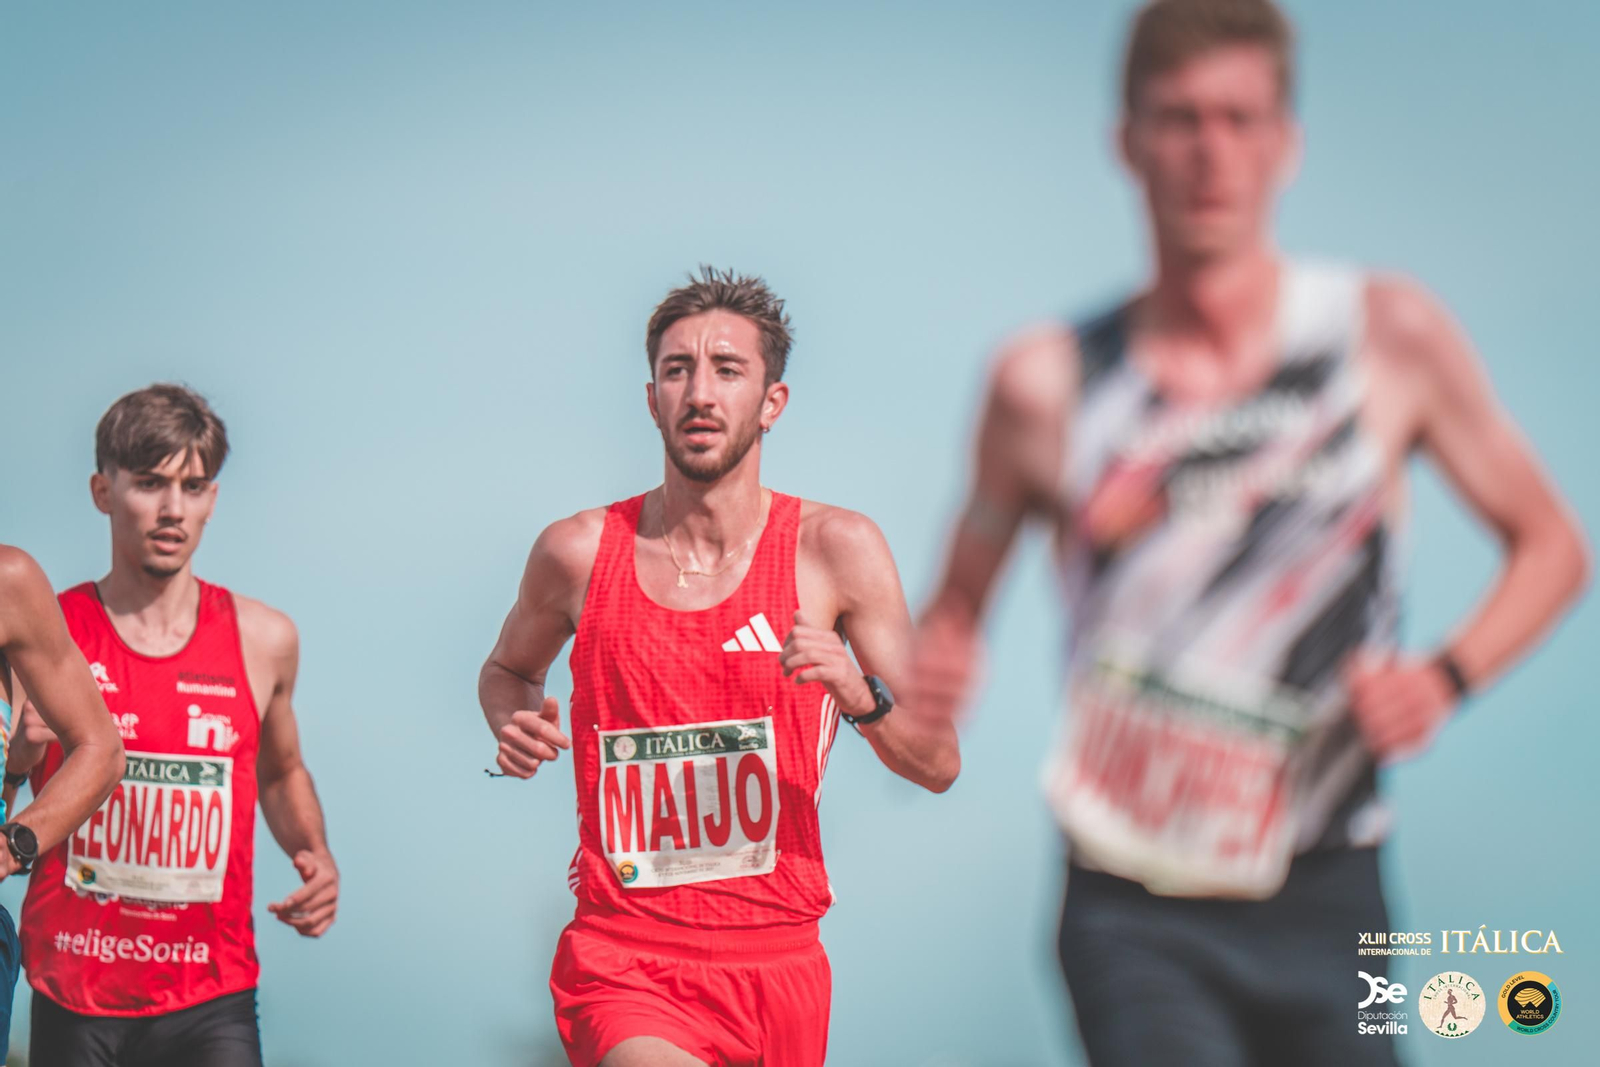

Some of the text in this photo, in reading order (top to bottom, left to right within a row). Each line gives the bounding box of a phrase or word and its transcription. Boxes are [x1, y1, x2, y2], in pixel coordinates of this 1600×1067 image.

[645, 732, 726, 755] ITÁLICA
[126, 758, 191, 782] TÁLICA
[604, 753, 773, 854] MAIJO
[54, 928, 210, 964] #eligeSoria
